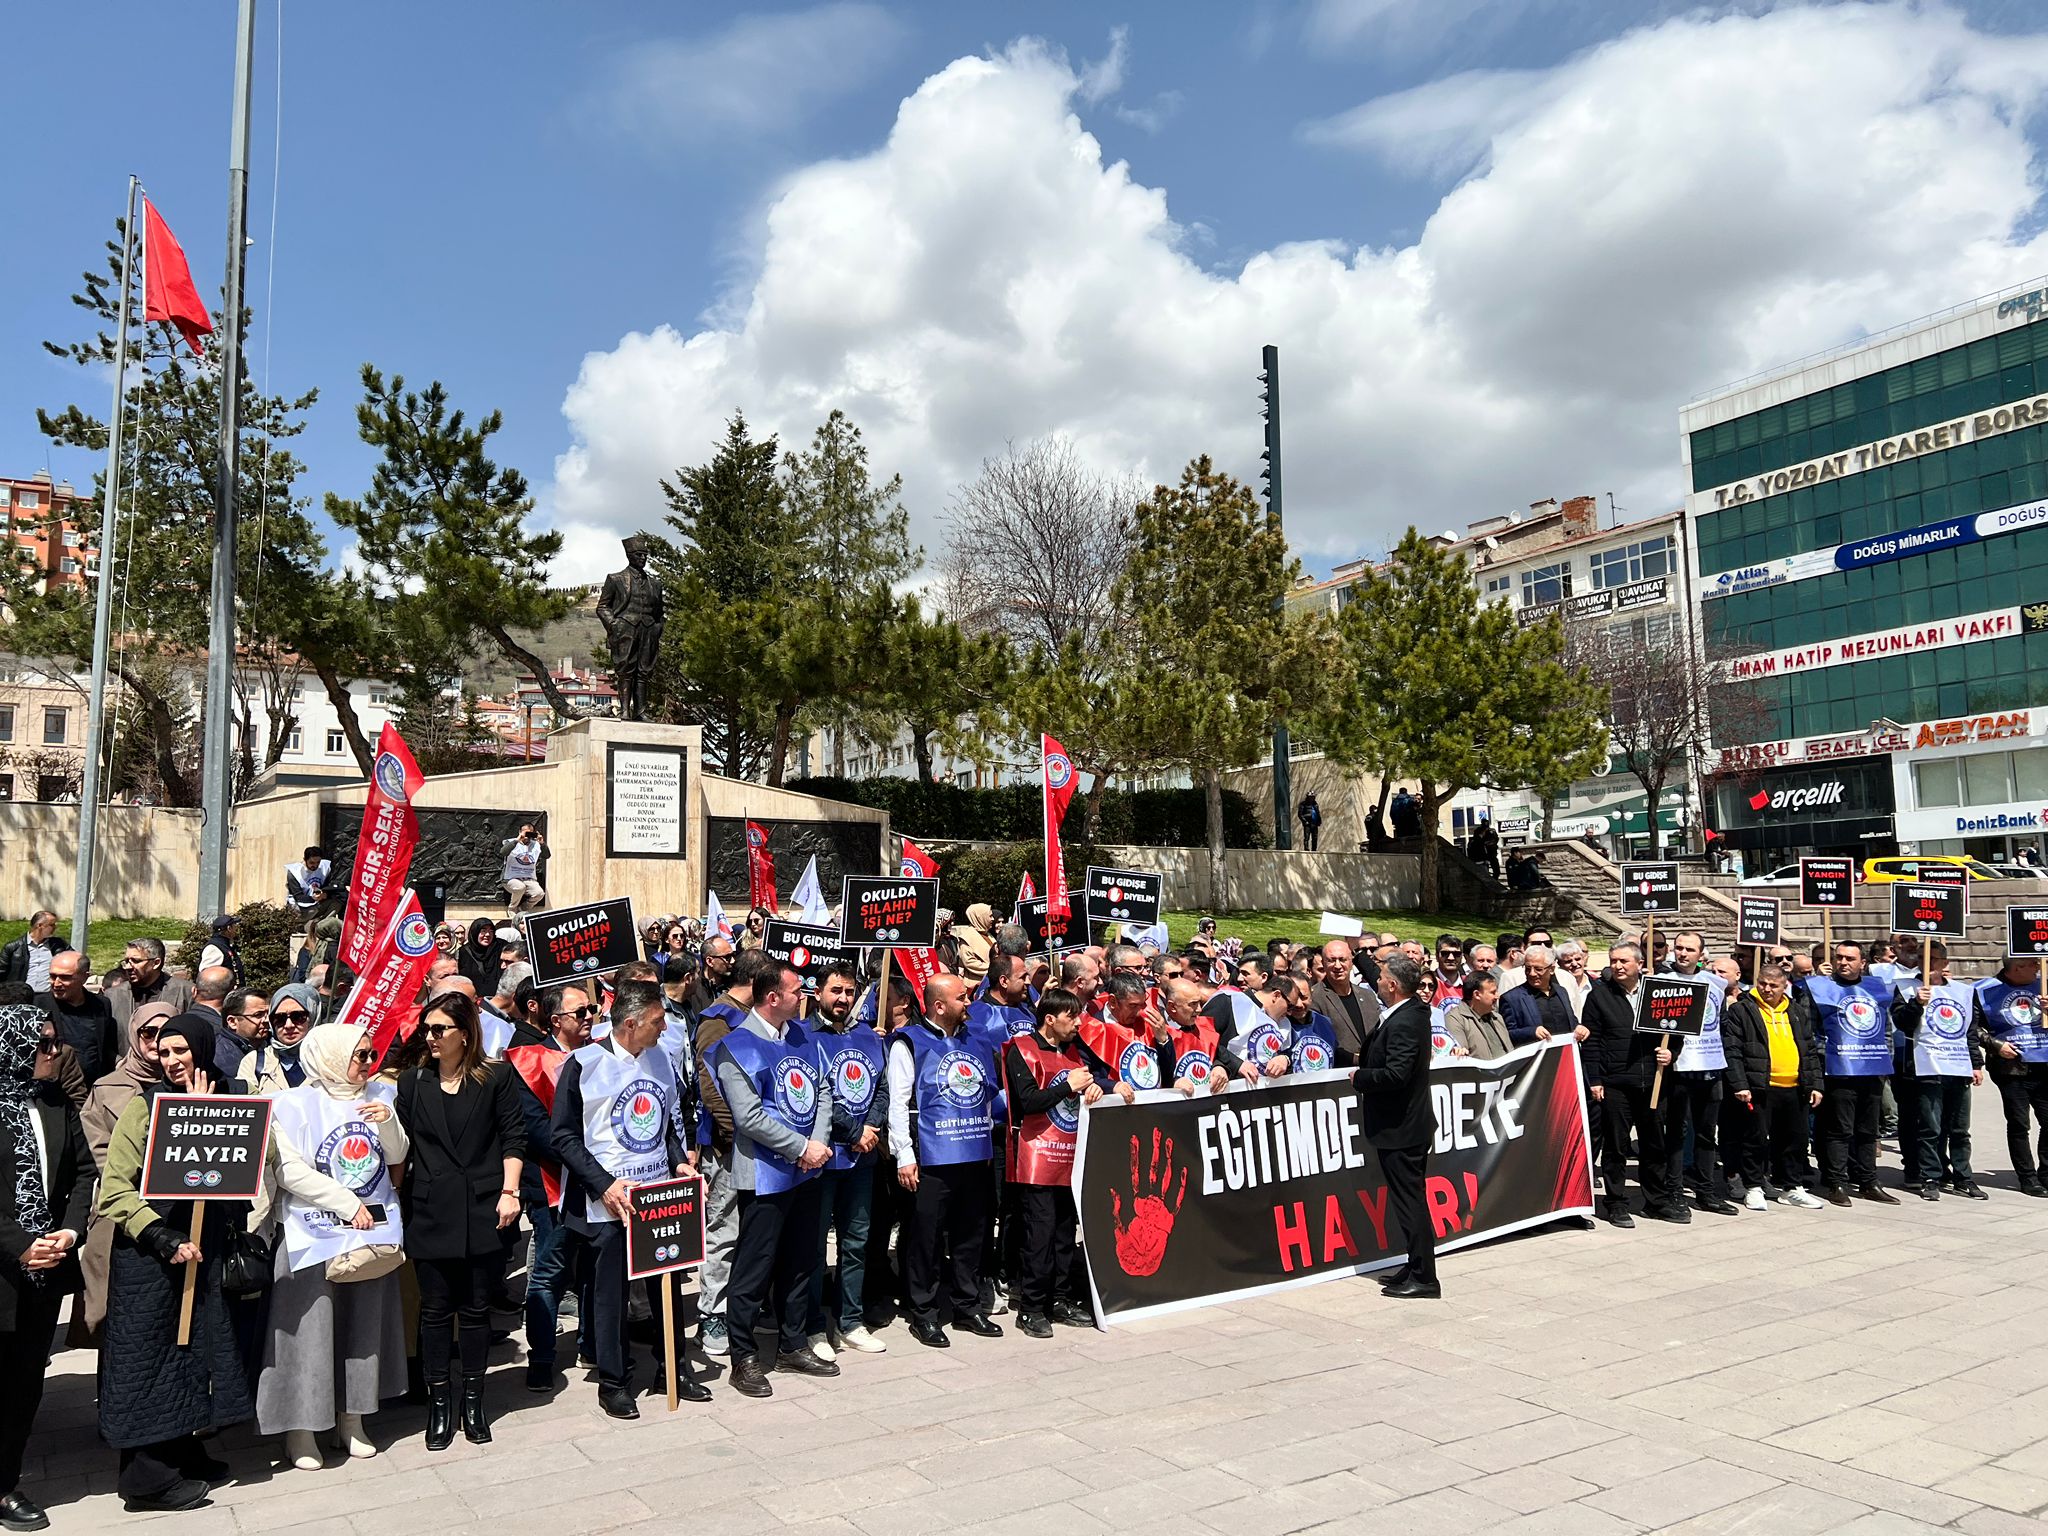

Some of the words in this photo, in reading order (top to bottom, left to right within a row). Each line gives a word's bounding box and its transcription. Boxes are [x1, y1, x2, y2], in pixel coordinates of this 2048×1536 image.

[1714, 482, 1754, 508] T.C.
[1759, 453, 1848, 496] YOZGAT
[1856, 418, 1966, 471] TİCARET
[1998, 505, 2048, 528] DOĞUŞ
[1853, 538, 1897, 560] DOĞUŞ
[1898, 524, 1961, 551] MİMARLIK
[1734, 566, 1770, 582] Atlas
[1627, 579, 1664, 598] AVUKAT
[1576, 592, 1611, 609] AVUKAT
[1733, 659, 1776, 677] İMAM
[1783, 644, 1833, 669] HATİP
[1841, 626, 1945, 659] MEZUNLARI
[1954, 614, 2013, 639] VAKFI
[1935, 711, 2030, 736] SEYRAN
[1977, 727, 2029, 741] EMLAK
[1805, 738, 1867, 757] İSRAFİL
[615, 778, 652, 786] KAHRAMANCA
[1770, 780, 1845, 812] arçelik
[1500, 819, 1529, 828] AVUKAT
[1956, 811, 2038, 831] DenizBank
[386, 807, 406, 863] SENDİKASI
[1807, 862, 1847, 870] YÜREĞİMİZ
[1807, 871, 1846, 879] YANGIN
[1101, 875, 1115, 885] BU
[1116, 878, 1147, 889] GİDİŞE
[1633, 872, 1644, 881] BU
[1644, 871, 1669, 881] GİDİŞE
[1816, 881, 1837, 889] YERİ
[861, 885, 917, 904] OKULDA
[1090, 888, 1107, 899] DUR
[1124, 892, 1155, 904] DİYELİM
[1625, 885, 1640, 894] DUR
[1651, 883, 1676, 892] DİYELİM
[1908, 888, 1948, 900] NEREYE
[860, 898, 917, 917] SİLAHIN
[1745, 907, 1774, 917] ŞİDDETE
[1920, 899, 1937, 909] BU
[863, 916, 881, 930] İŞİ
[886, 911, 912, 926] NE?
[1913, 908, 1943, 922] GİDİŞ
[547, 909, 609, 940] OKULDA
[1744, 919, 1774, 930] HAYIR
[549, 921, 611, 953] SİLAHIN
[783, 931, 799, 944] BU
[802, 935, 841, 951] GİDİŞE
[555, 948, 576, 965] İŞİ
[580, 936, 609, 956] NE?
[768, 949, 789, 961] DUR
[384, 960, 414, 1008] SENDİKASI
[1652, 986, 1693, 999] OKULDA
[1650, 997, 1692, 1009] SİLAHIN
[1651, 1008, 1665, 1019] İŞİ
[1667, 1007, 1688, 1017] NE?
[167, 1105, 257, 1119] EĞİTİMCİYE
[170, 1122, 250, 1138] ŞİDDETE
[1197, 1095, 1365, 1196] EĞİTİMDE
[164, 1146, 248, 1164] HAYIR
[639, 1187, 694, 1205] YÜREĞİMİZ
[638, 1202, 693, 1223] YANGIN
[651, 1221, 682, 1239] YERİ
[1273, 1171, 1480, 1273] HAYR!
